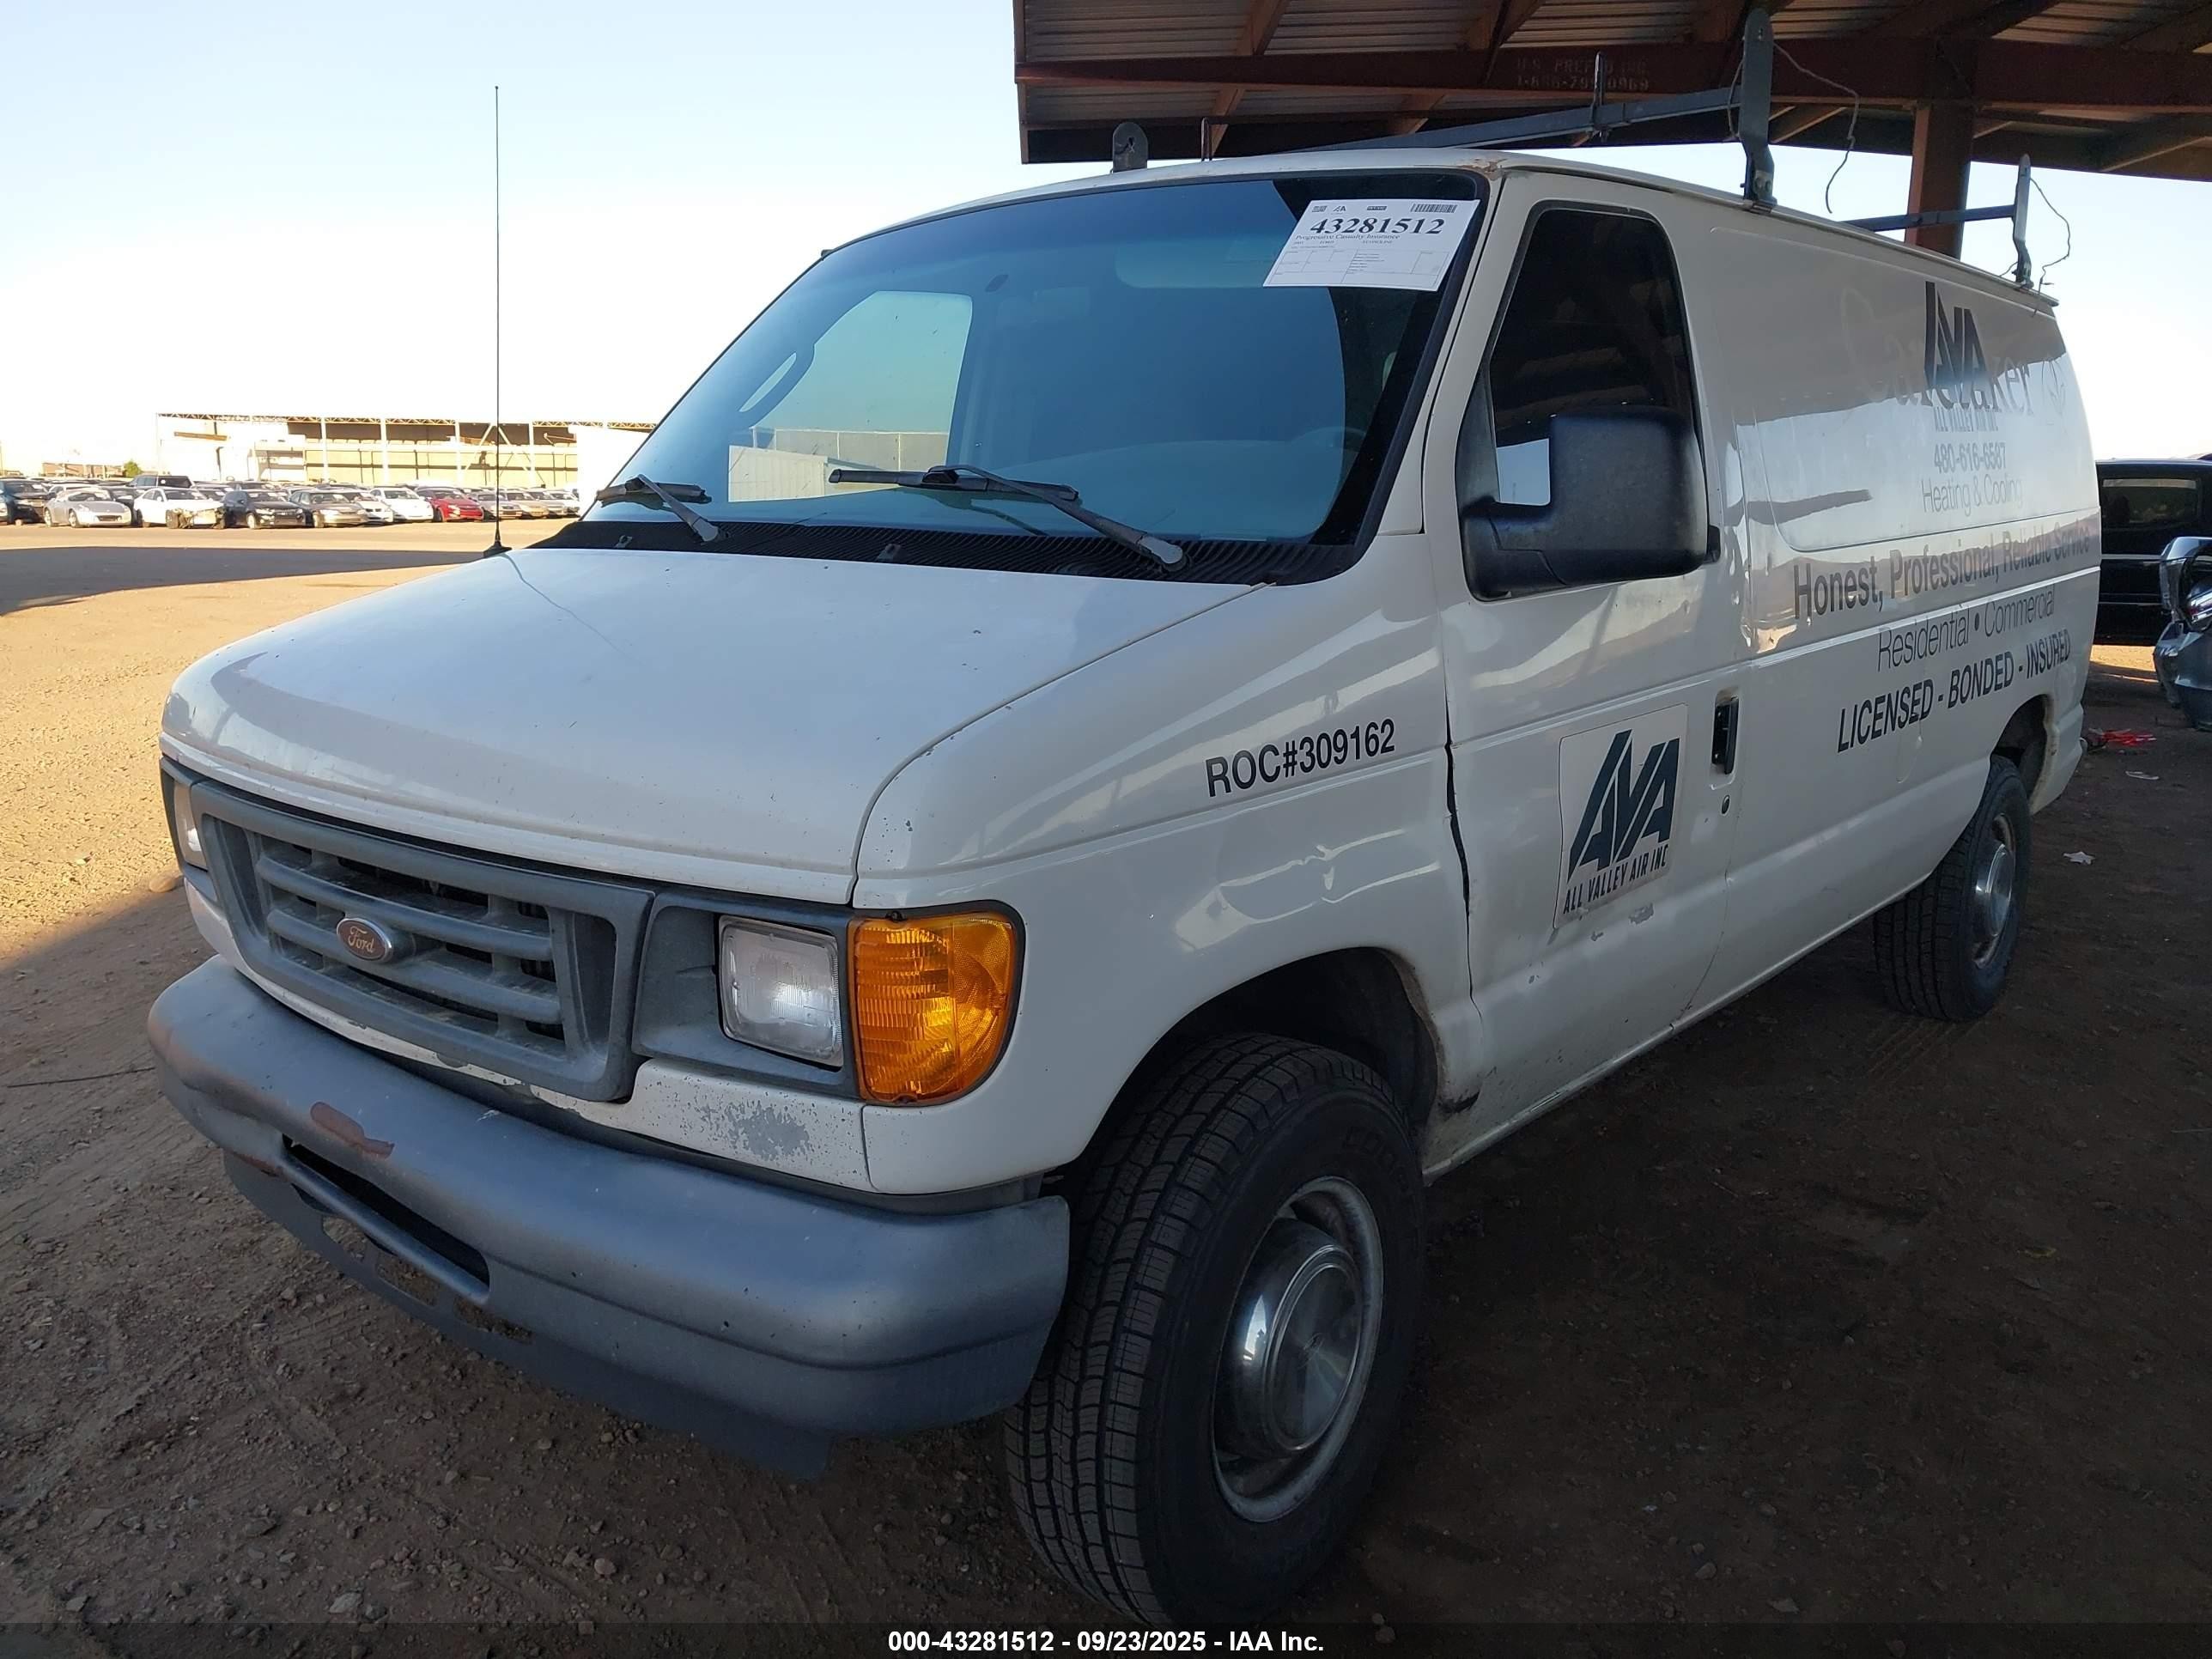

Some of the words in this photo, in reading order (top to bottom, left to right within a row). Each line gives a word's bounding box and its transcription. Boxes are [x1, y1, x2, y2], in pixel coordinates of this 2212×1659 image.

[1310, 218, 1444, 234] 43281512
[1921, 477, 1972, 517] Heating
[1984, 473, 2023, 509] Cooling
[1793, 556, 1884, 620] Honest,
[1890, 533, 2000, 599] Professional,
[2002, 526, 2051, 574] Reliable
[2054, 521, 2090, 559] Service
[1877, 603, 1970, 672] Residential
[1984, 588, 2055, 637] Commercial
[1837, 678, 1934, 753] LICENSED
[1948, 651, 2014, 709] BONDED
[2026, 628, 2071, 679] INSURED
[1205, 718, 1395, 798] ROC#309162
[1563, 883, 1583, 915] ALL
[1588, 861, 1629, 903] VALLEY
[1629, 853, 1650, 883] AIR
[1650, 843, 1669, 872] INC
[348, 927, 374, 953] Ford
